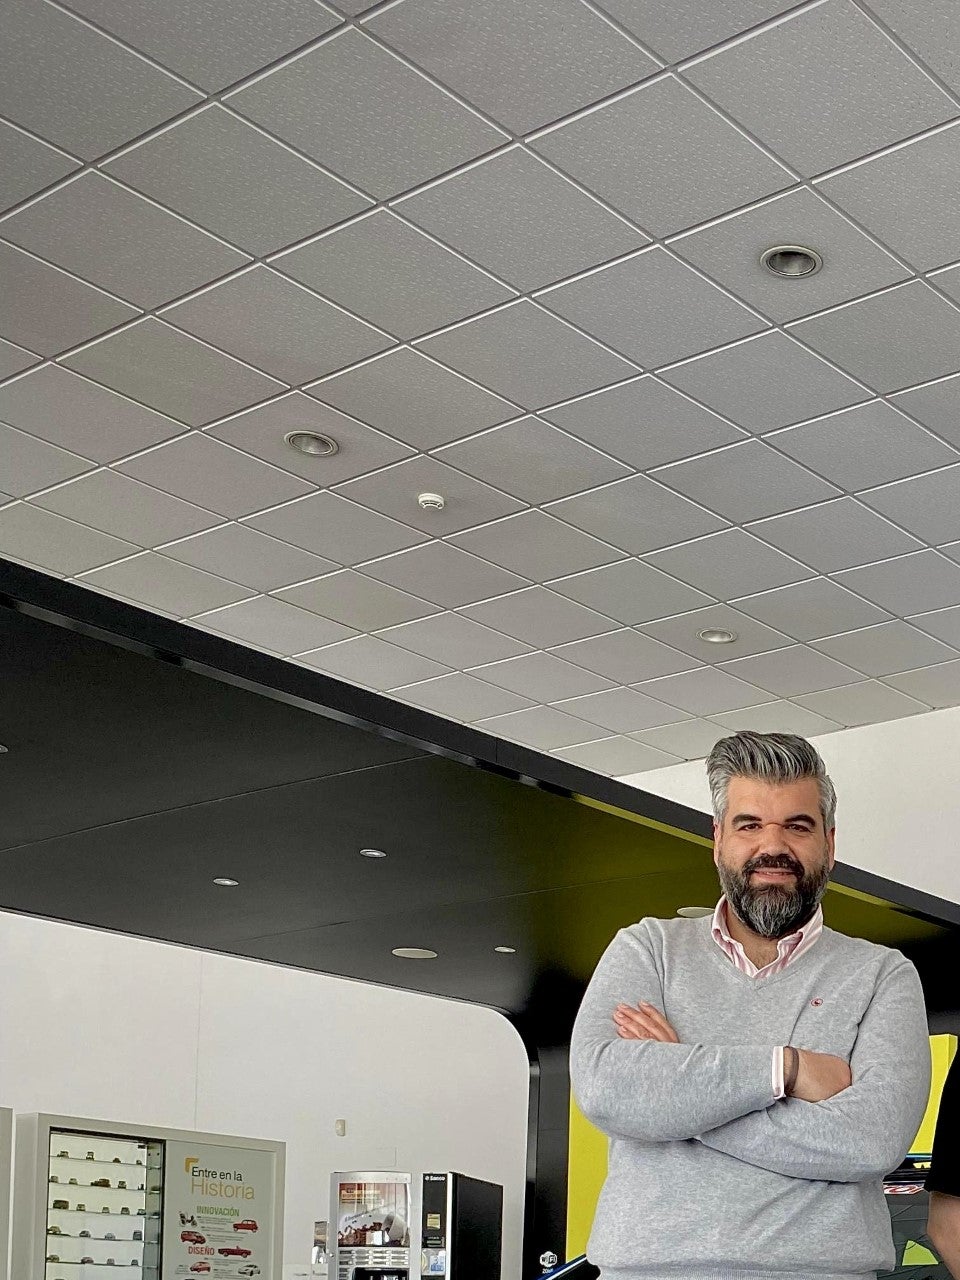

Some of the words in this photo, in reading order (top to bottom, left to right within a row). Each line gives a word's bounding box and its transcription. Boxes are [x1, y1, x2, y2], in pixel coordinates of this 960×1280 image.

[192, 1166, 218, 1179] Entre
[219, 1171, 232, 1181] en
[233, 1170, 243, 1182] la
[191, 1177, 256, 1200] Historia
[196, 1205, 240, 1217] INNOVACIÓN
[188, 1246, 215, 1256] DISEÑO
